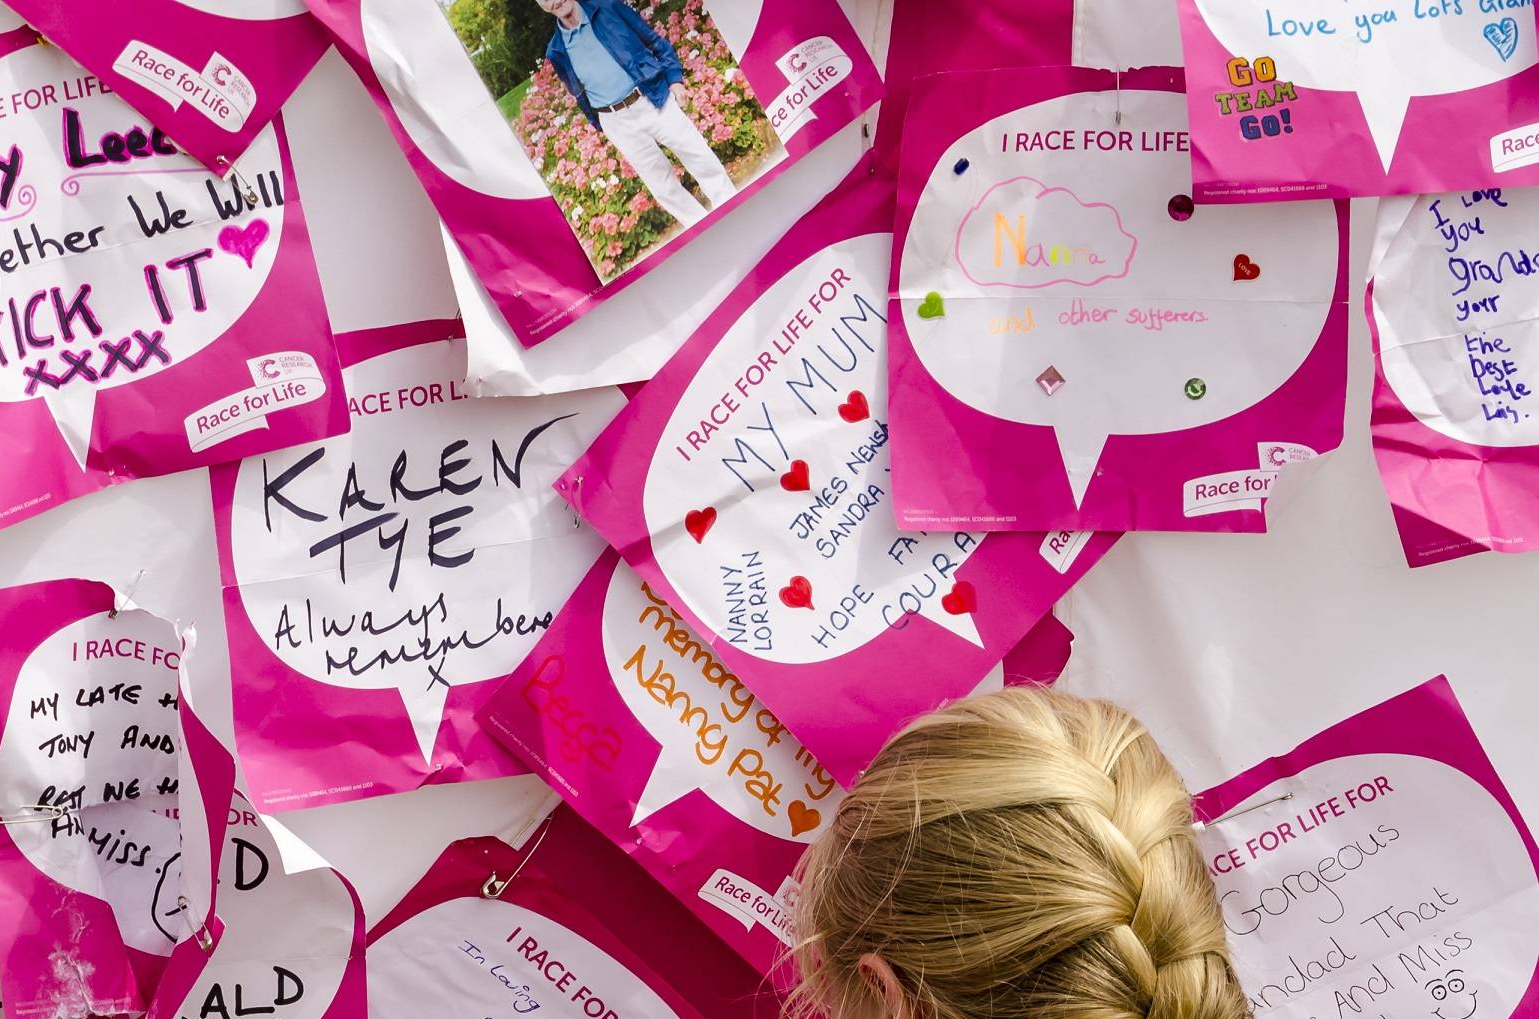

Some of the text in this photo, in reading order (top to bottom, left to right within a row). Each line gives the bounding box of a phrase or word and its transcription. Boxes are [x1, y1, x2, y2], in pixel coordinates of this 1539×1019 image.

[1267, 9, 1398, 44] Love you
[12, 85, 57, 114] FOR
[63, 75, 114, 101] LIFE
[132, 49, 230, 120] Race for Life
[791, 61, 838, 110] for Life
[1214, 80, 1299, 117] TEAM
[1226, 55, 1278, 88] GO
[1015, 130, 1190, 153] RACE FOR LIFE
[1239, 107, 1295, 142] GO!
[127, 190, 194, 239] We
[1441, 217, 1485, 253] you
[143, 248, 215, 325] IT
[990, 298, 1119, 336] and other
[686, 266, 852, 452] RACE FOR LIFE FOR
[196, 379, 308, 435] Race for Life
[397, 386, 445, 412] FOR
[722, 293, 888, 493] MY MUM
[262, 411, 581, 533] KAREN
[788, 475, 849, 542] JAMES
[813, 484, 886, 560] SANDRA
[309, 505, 476, 592] TYE
[275, 592, 447, 650] Always
[720, 564, 750, 643] NANNY
[810, 583, 875, 648] HOPE
[87, 637, 146, 662] RACE
[30, 683, 143, 721] MY LATE
[38, 724, 176, 759] TONY AND
[1246, 774, 1395, 861] FOR LIFE FOR
[1219, 821, 1401, 937] Gorgeous
[1360, 887, 1460, 939] That
[517, 935, 577, 993] RACE
[1398, 929, 1473, 984] Miss
